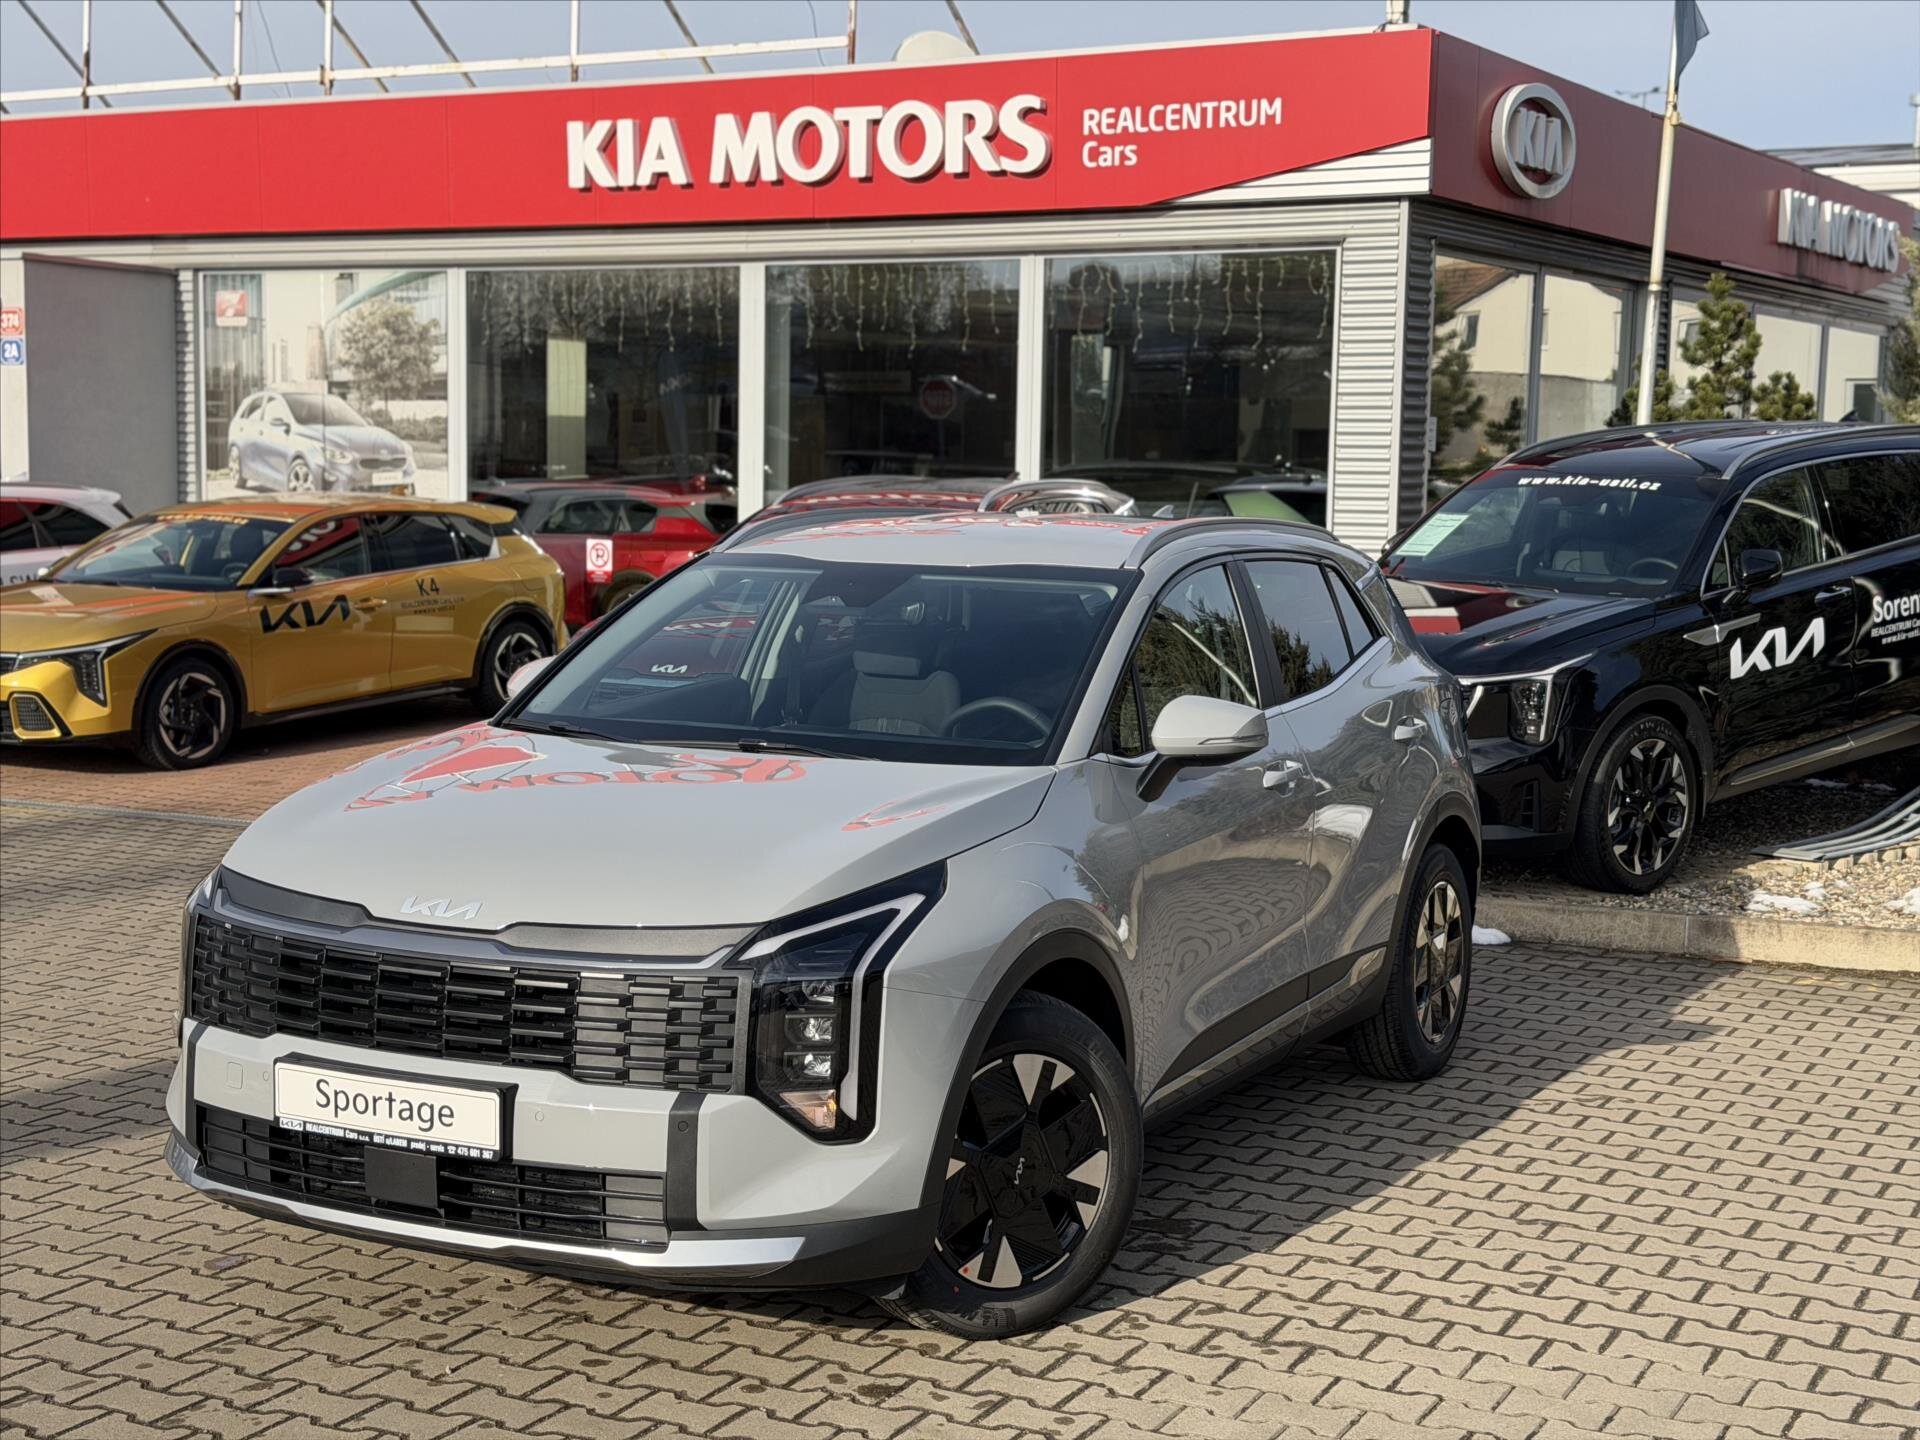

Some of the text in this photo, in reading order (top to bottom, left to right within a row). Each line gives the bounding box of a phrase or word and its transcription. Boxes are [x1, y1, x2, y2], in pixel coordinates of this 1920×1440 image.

[1081, 97, 1282, 136] REALCENTRUM
[566, 94, 1050, 191] KIA MOTORS
[1082, 140, 1138, 168] Cars
[1514, 106, 1563, 176] KIA
[1777, 187, 1900, 273] KIA MOTORS
[4, 343, 19, 358] 2A
[1517, 475, 1662, 491] www.kia-usti.cz
[416, 577, 440, 596] K4
[260, 594, 350, 633] KIA
[1872, 594, 1920, 623] Soren
[1730, 617, 1825, 679] KIA
[650, 664, 688, 673] KIA
[400, 896, 483, 920] KIA
[315, 1078, 455, 1132] Sportage
[281, 1119, 303, 1130] KIA
[305, 1122, 345, 1137] REALCENTRUM
[345, 1129, 358, 1140] Cars
[457, 1147, 469, 1156] 475
